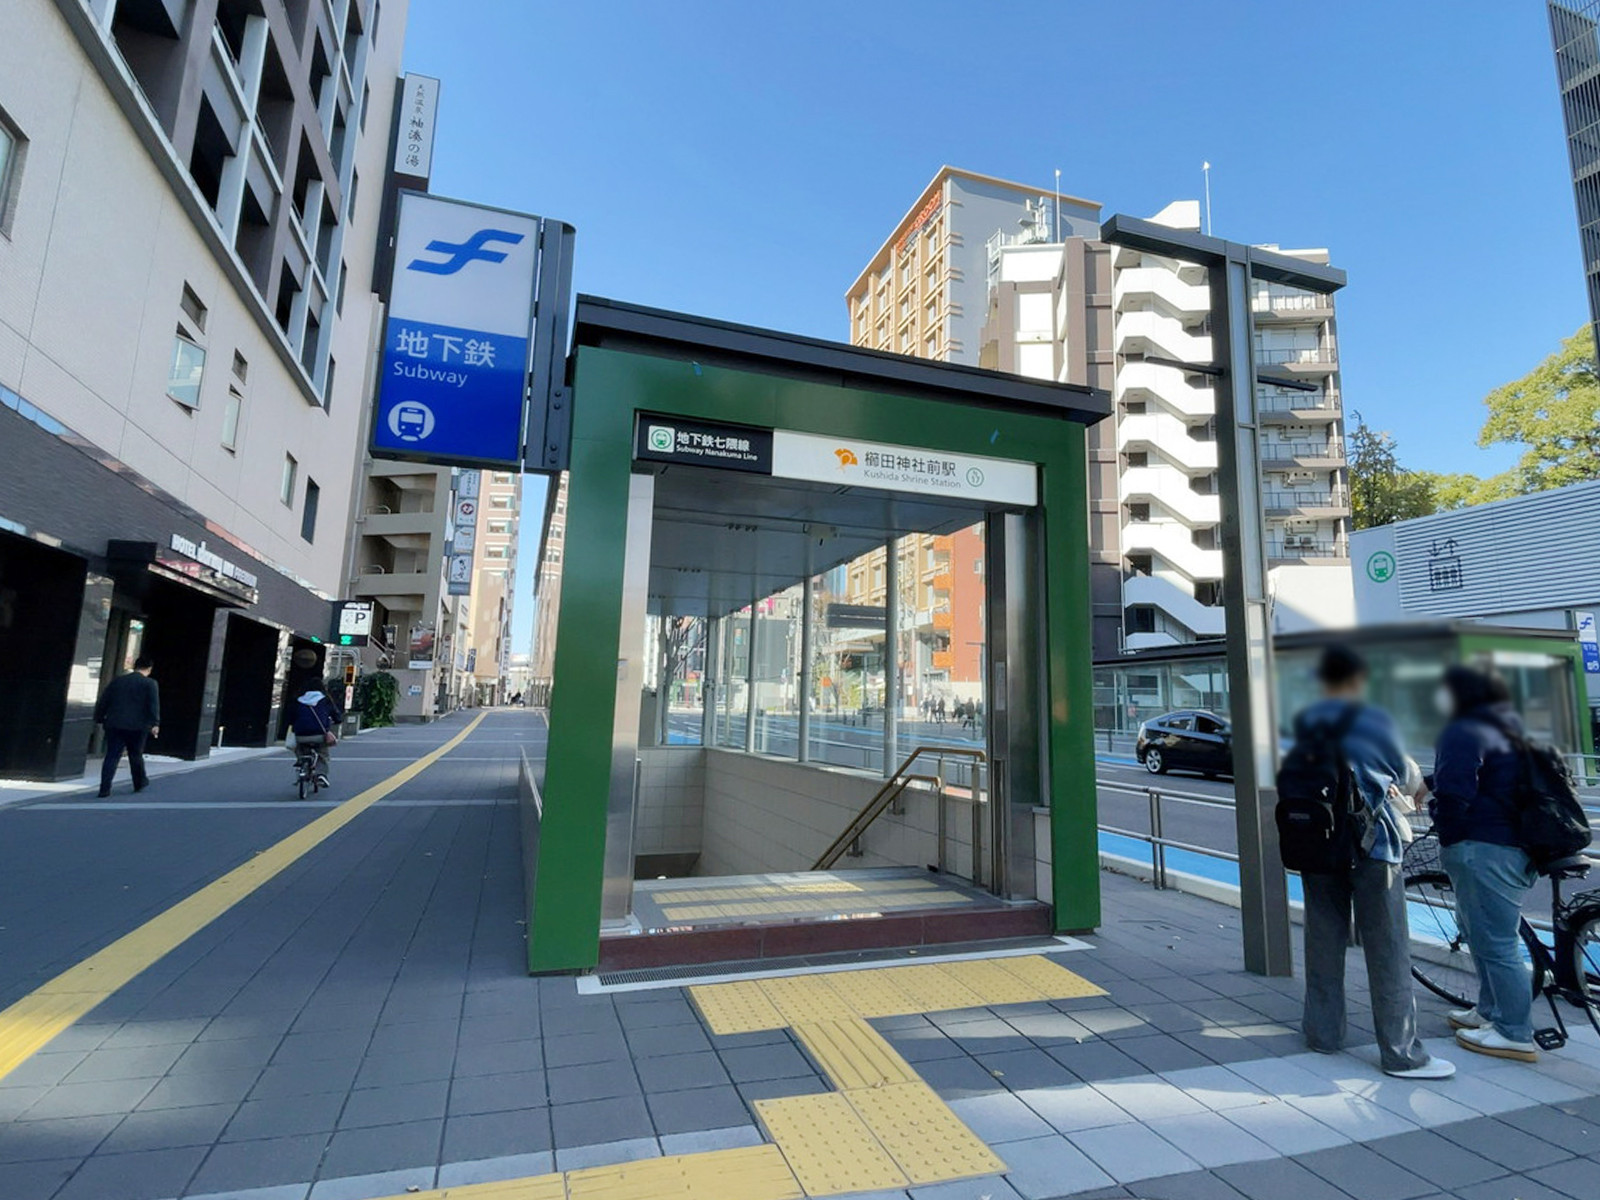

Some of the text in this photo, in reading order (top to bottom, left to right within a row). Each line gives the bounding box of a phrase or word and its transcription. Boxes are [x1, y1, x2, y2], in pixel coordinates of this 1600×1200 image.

[395, 328, 496, 369] 地下鉄
[393, 361, 469, 388] Subway
[677, 432, 750, 452] 地下鉄七隈線
[677, 445, 758, 460] Subway Nanakuma Line
[865, 451, 956, 477] 櫛田神社前駅
[864, 470, 962, 489] Kushida Shrine Station
[354, 612, 367, 625] P
